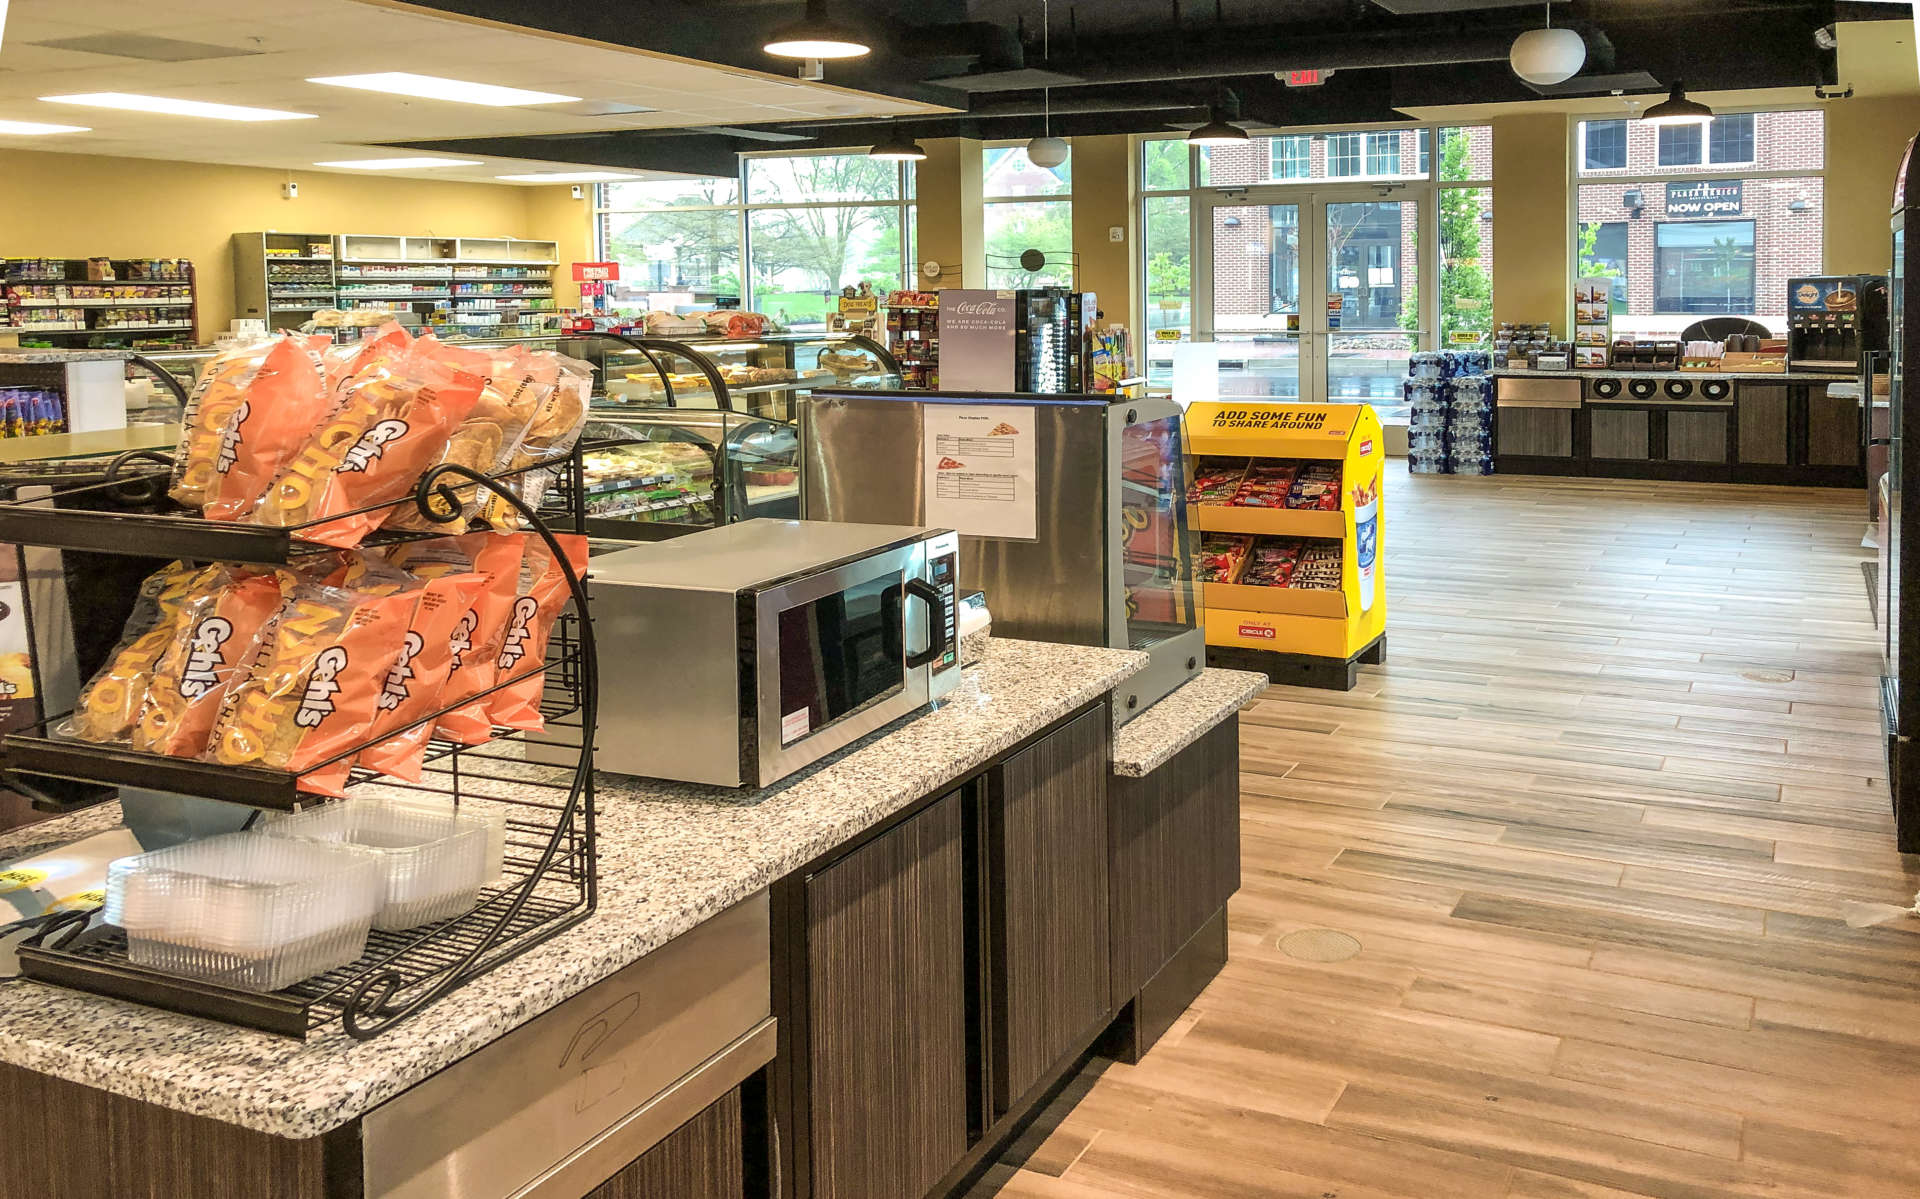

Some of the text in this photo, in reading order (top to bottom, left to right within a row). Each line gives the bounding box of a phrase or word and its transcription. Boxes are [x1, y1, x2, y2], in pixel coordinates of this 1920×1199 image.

[1291, 70, 1318, 84] EXIT
[1668, 202, 1740, 213] NOW OPEN
[1212, 419, 1323, 430] TO SHARE AROUND
[1214, 410, 1328, 422] ADD SOME FUN
[498, 596, 539, 670] Gehl's
[179, 616, 233, 701] Gehl's
[378, 630, 425, 711] Gehl's
[293, 644, 348, 729] Gehl's
